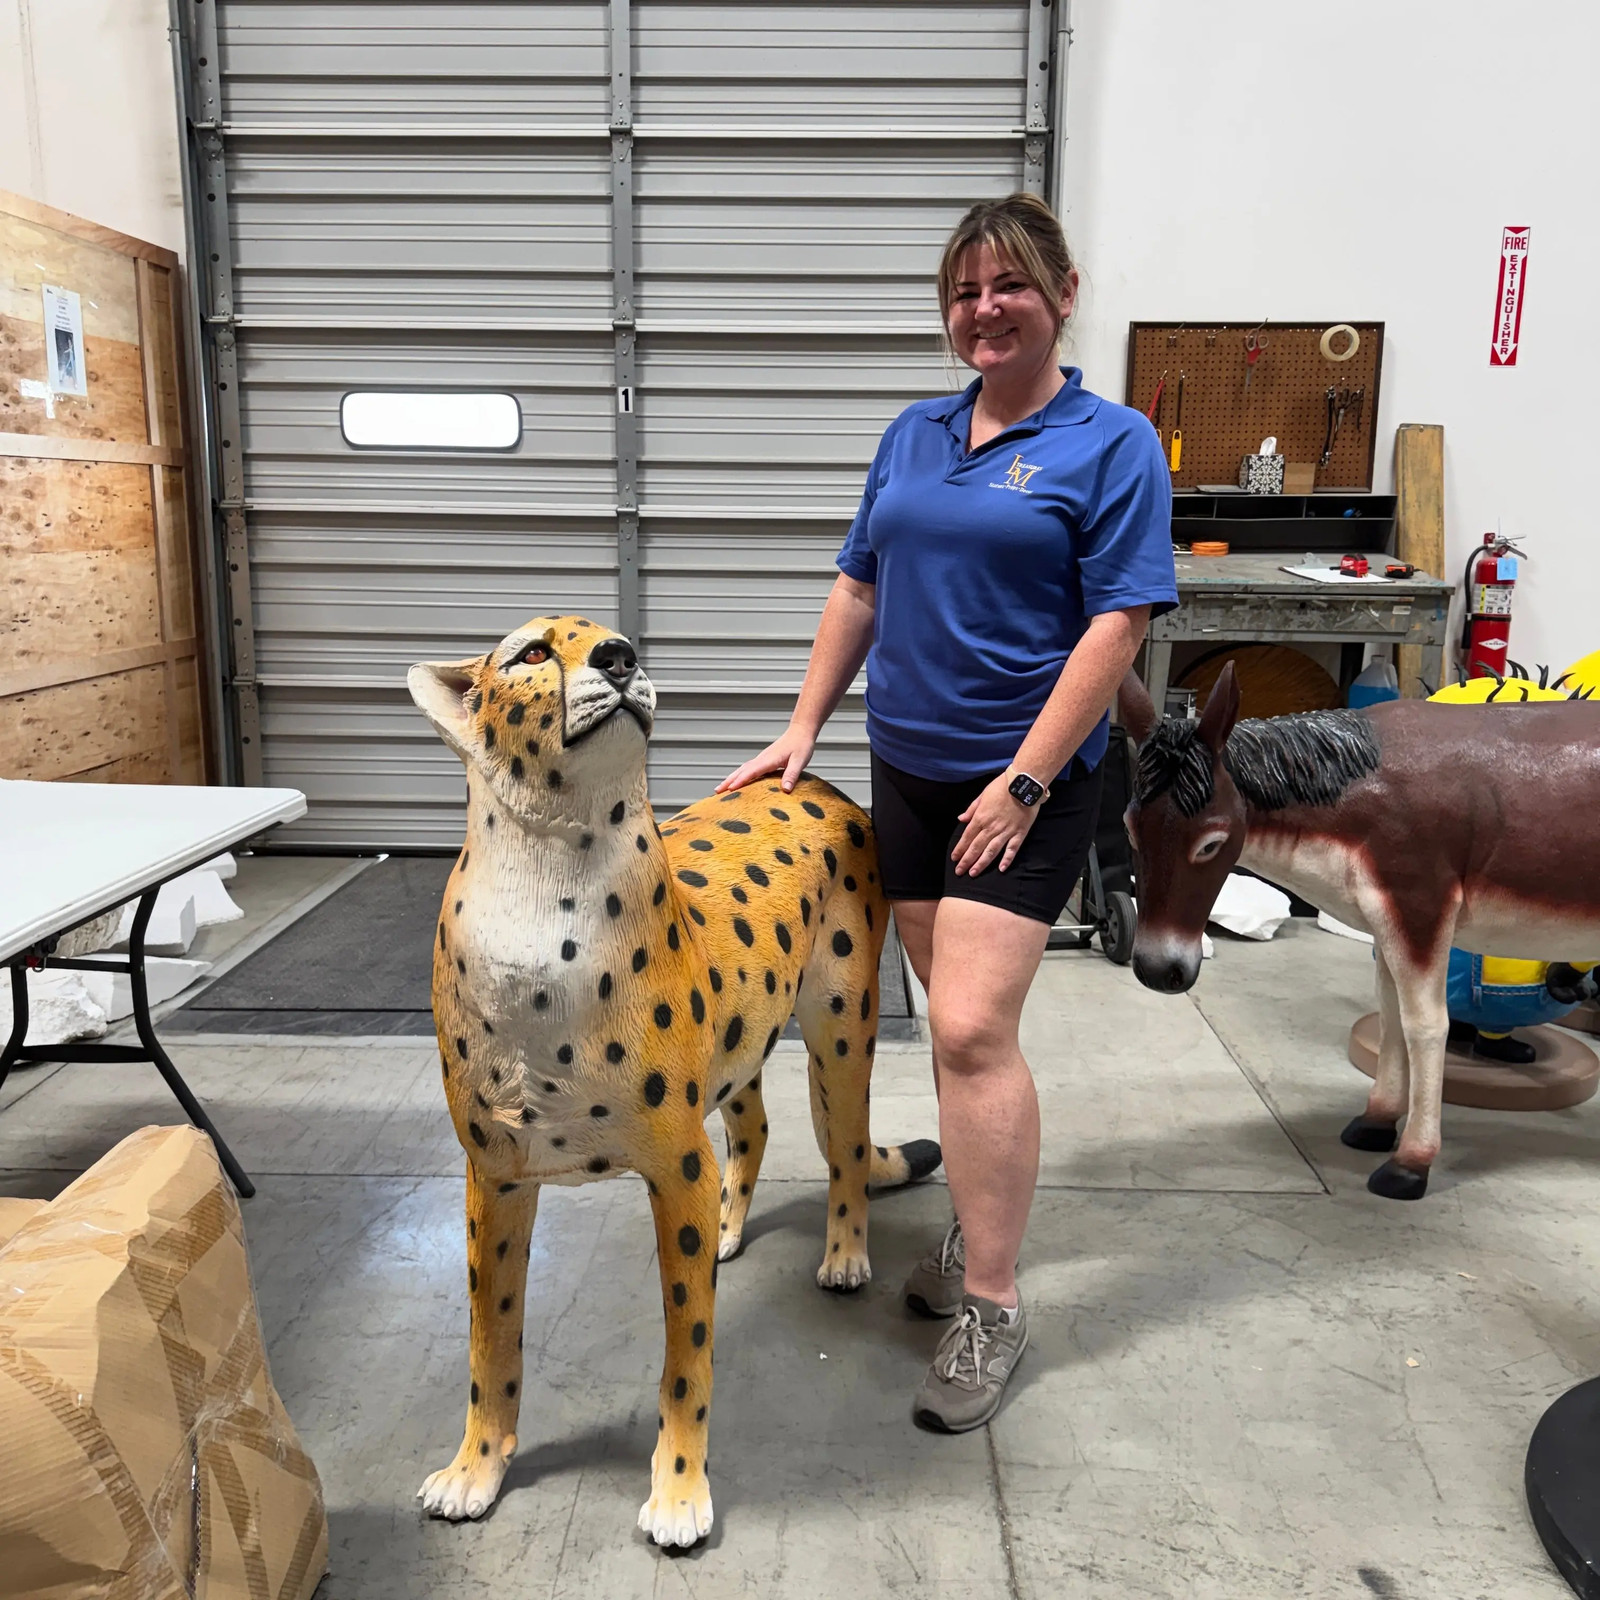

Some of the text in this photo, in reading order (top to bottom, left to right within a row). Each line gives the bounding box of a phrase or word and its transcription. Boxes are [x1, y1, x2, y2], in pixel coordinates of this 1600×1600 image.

[1504, 236, 1528, 250] FIRE
[1500, 254, 1518, 355] EXTINGUISHER
[621, 388, 630, 411] 1
